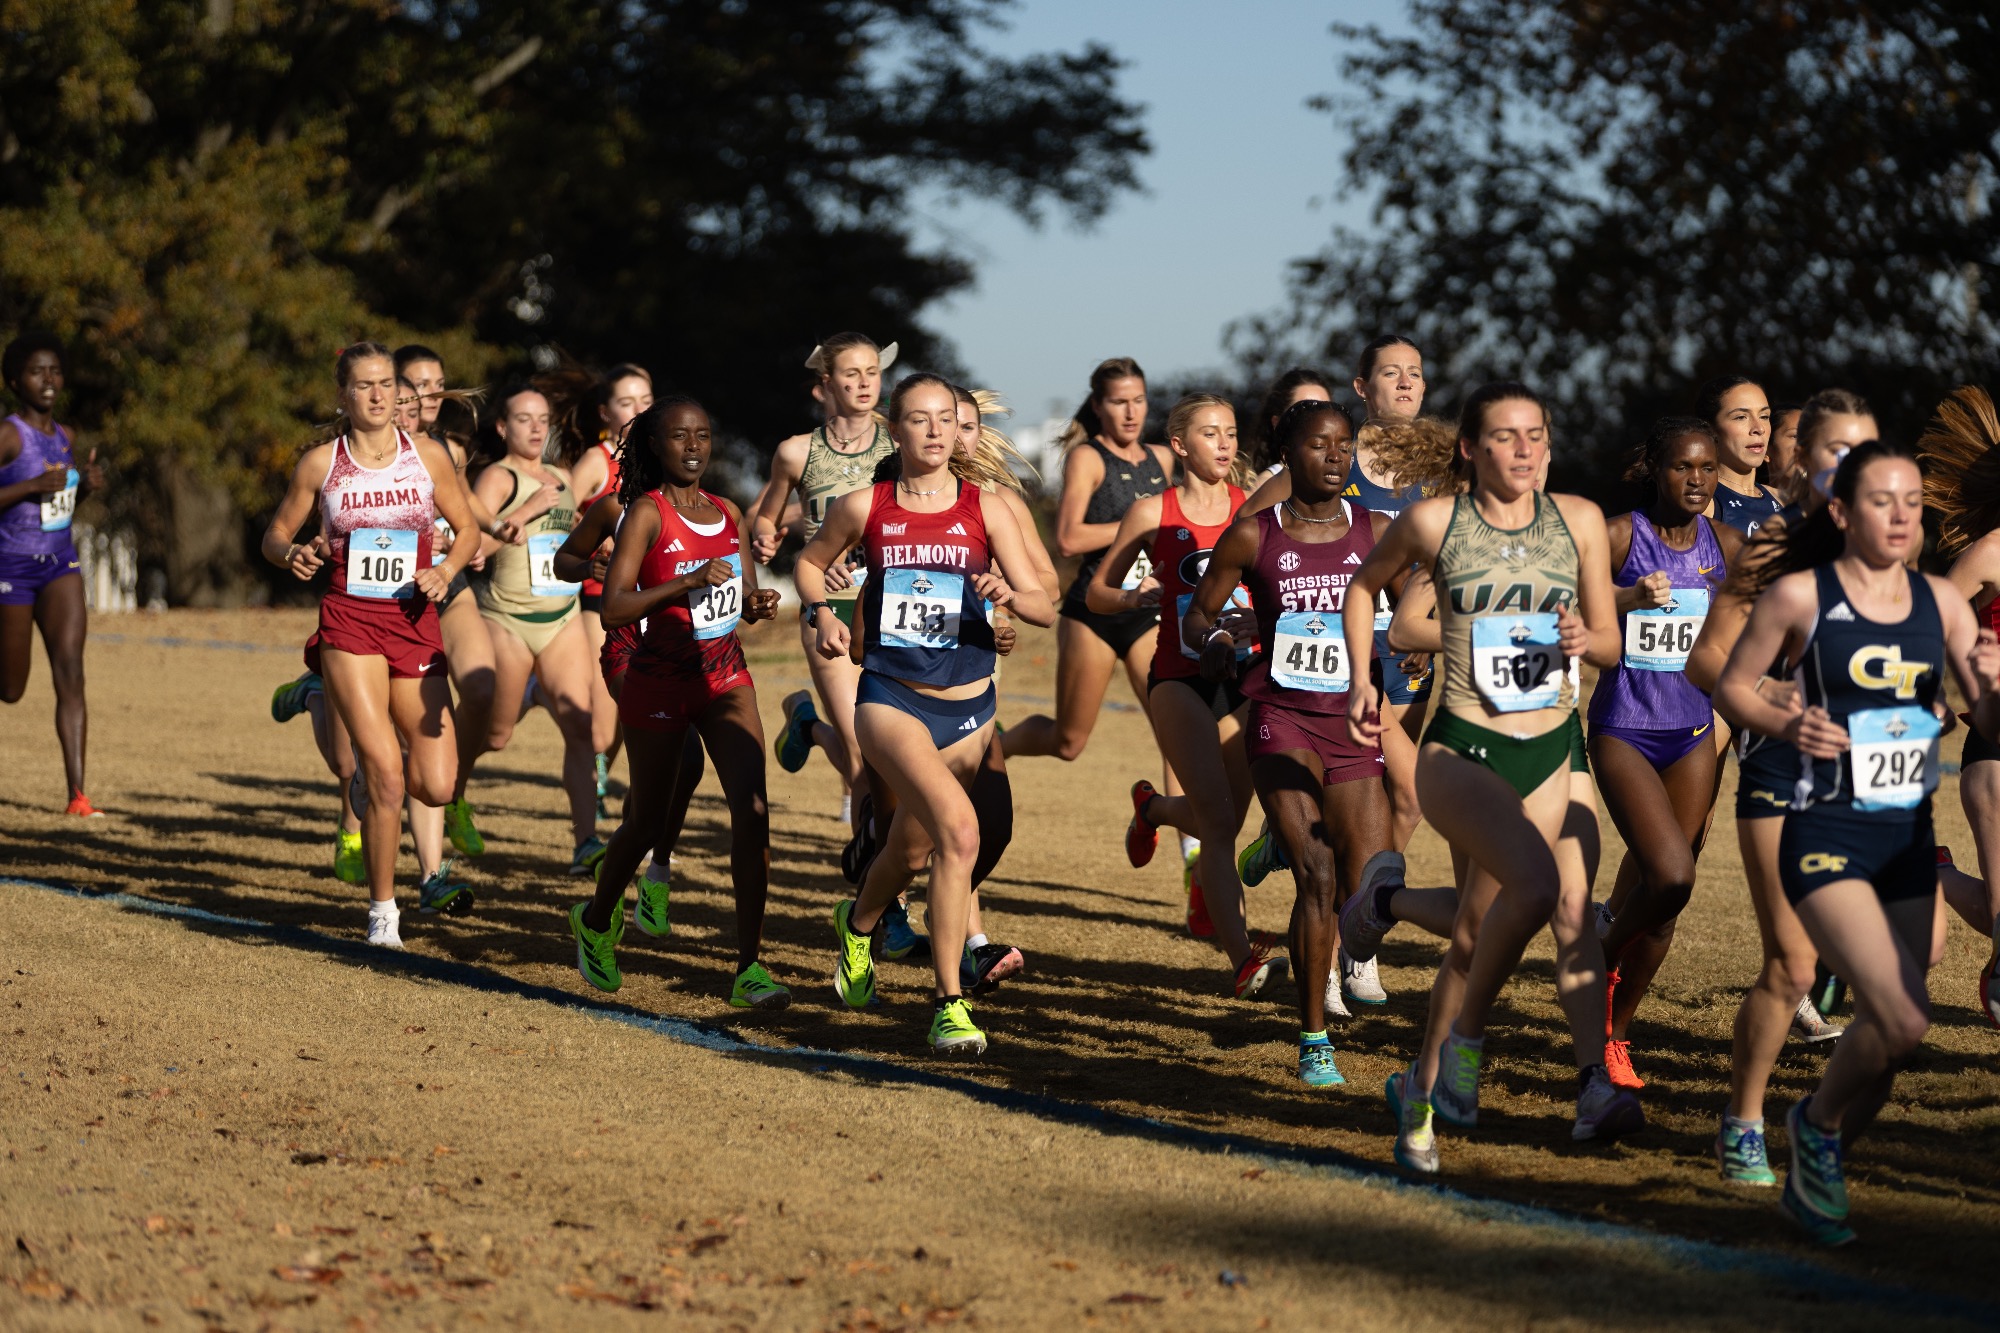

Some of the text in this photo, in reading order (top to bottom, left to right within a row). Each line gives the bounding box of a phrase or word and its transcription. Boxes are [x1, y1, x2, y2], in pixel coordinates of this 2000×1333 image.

[340, 488, 422, 510] ALABAMA
[882, 522, 908, 534] VALLEY
[1176, 528, 1190, 541] SEC
[360, 556, 404, 582] 106
[882, 544, 970, 569] BELMONT
[1279, 553, 1300, 571] SEC
[1279, 574, 1353, 593] MISSISSI
[701, 586, 737, 622] 322
[1281, 588, 1347, 613] STAT
[894, 601, 946, 632] 133
[1639, 622, 1693, 653] 546
[1285, 642, 1340, 675] 416
[1491, 652, 1551, 689] 562
[1848, 644, 1933, 699] GT
[1868, 749, 1926, 790] 292
